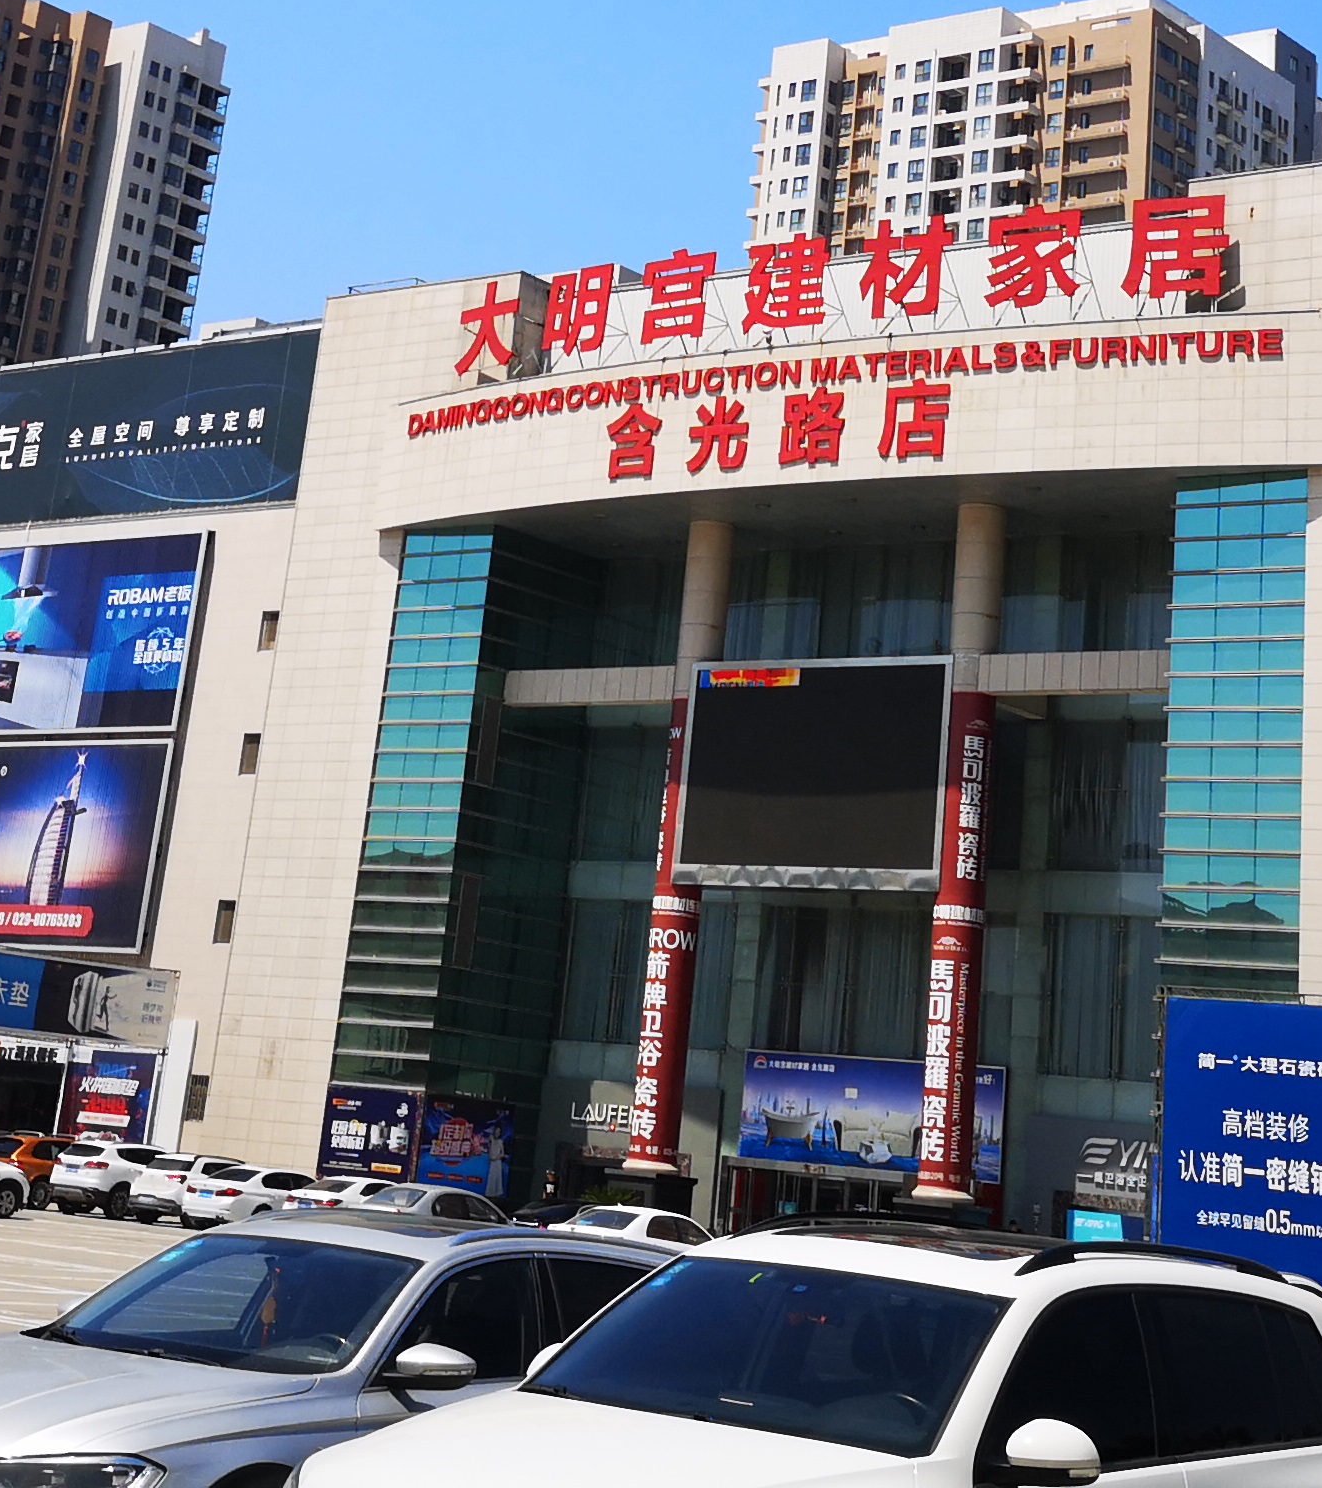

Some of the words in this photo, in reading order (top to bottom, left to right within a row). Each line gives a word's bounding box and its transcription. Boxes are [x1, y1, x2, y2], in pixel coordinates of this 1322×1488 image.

[454, 194, 1230, 378] 大明宫建材家居
[67, 420, 154, 448] 全屋空间
[174, 407, 265, 437] 尊享定制
[407, 386, 564, 440] DAMINGGONG
[566, 358, 802, 410] CONSTRUCTION
[607, 378, 951, 482] 含光路店
[19, 421, 44, 467] 家居
[1222, 1108, 1309, 1143] 高档装修
